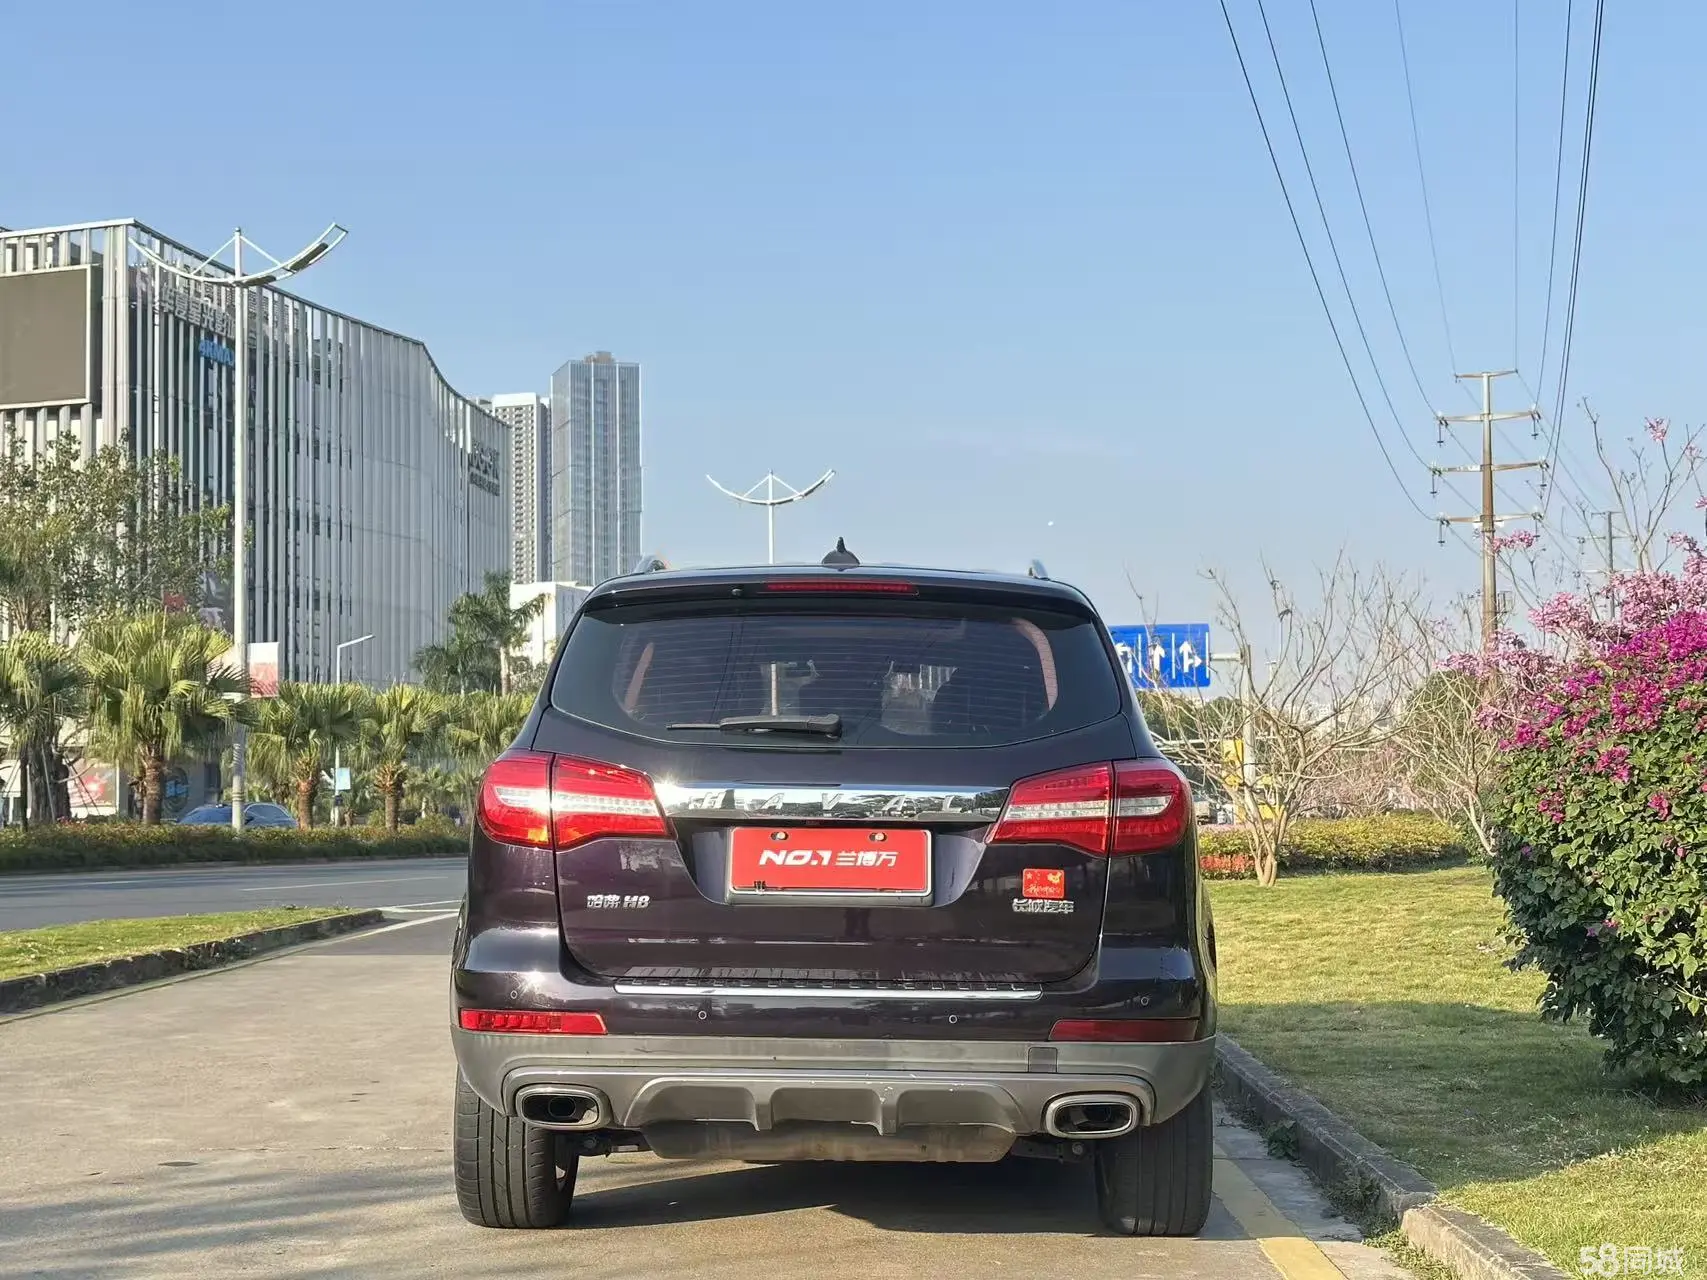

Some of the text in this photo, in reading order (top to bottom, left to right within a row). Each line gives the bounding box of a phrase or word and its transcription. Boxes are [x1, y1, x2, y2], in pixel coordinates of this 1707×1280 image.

[701, 791, 962, 812] HAVAL
[759, 849, 833, 866] NO.1
[623, 895, 650, 909] H8
